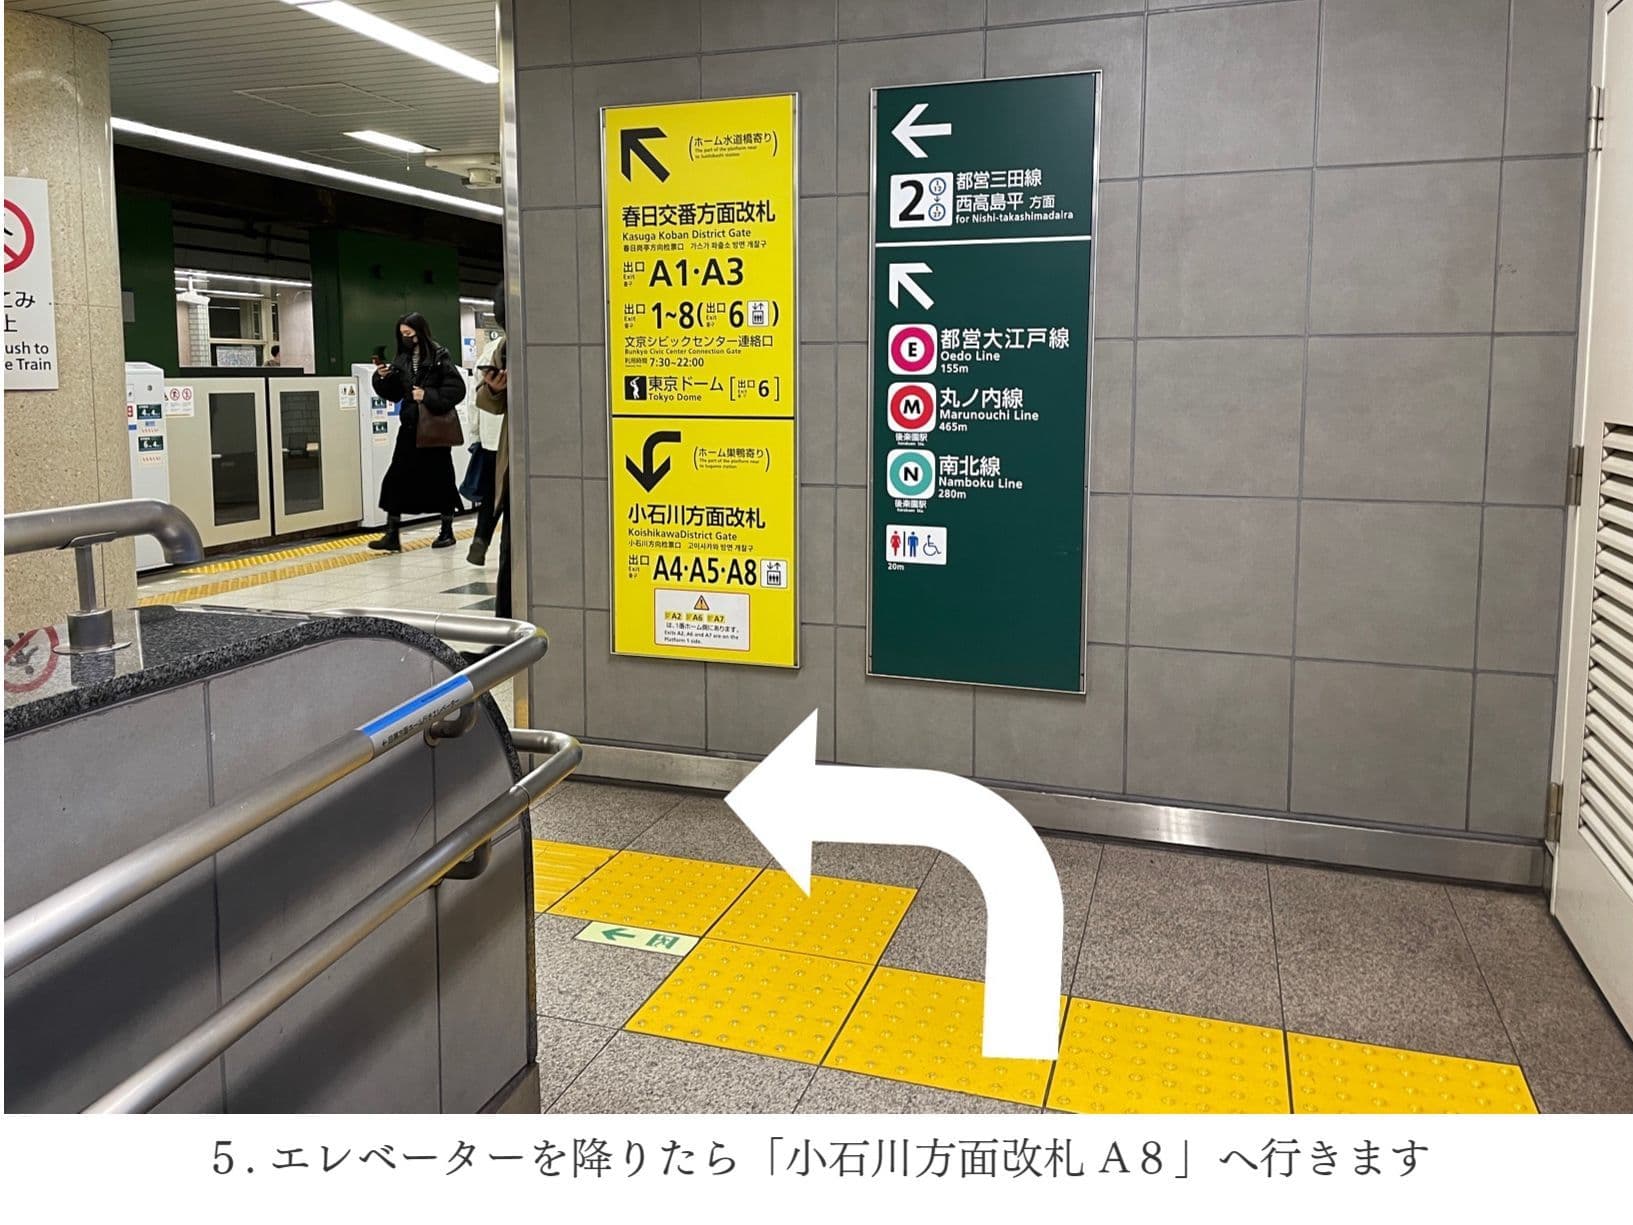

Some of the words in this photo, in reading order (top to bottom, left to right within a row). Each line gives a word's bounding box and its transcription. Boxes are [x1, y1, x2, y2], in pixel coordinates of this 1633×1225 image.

[956, 168, 1042, 190] 都営三田線
[898, 180, 924, 222] 2
[956, 192, 1024, 212] 西高島平
[1029, 194, 1056, 209] 方面
[622, 200, 776, 228] 春日交番方面改札
[956, 214, 970, 224] for
[972, 210, 1074, 224] Nishi-takashimadaira
[622, 232, 656, 242] Kasuga
[659, 230, 689, 240] Koban
[692, 229, 725, 239] District
[728, 228, 752, 238] Gate
[624, 261, 645, 273] 出口
[624, 303, 646, 314] 出口
[625, 335, 773, 348] 文京シビックセンター連絡口
[940, 328, 1070, 350] 都営大江戸線
[5, 341, 31, 354] ush
[34, 343, 49, 354] to
[908, 342, 917, 357] E
[940, 351, 972, 361] Oedo
[976, 350, 1000, 361] Line
[16, 358, 51, 370] Train
[941, 364, 968, 373] 155m
[648, 376, 724, 392] 東京ドーム
[758, 380, 770, 397] 6
[648, 393, 674, 403] Tokyo
[940, 387, 1024, 408] 丸ノ内線
[903, 400, 920, 414] M
[940, 409, 1010, 420] Marunouchi
[1014, 410, 1039, 421] Line
[939, 422, 968, 432] 465m
[938, 455, 1000, 477] 南北線
[904, 466, 918, 481] N
[938, 476, 994, 488] Namboku
[998, 478, 1023, 489] Line
[938, 489, 966, 499] 280m
[628, 503, 766, 529] 小石川方面改札
[716, 533, 737, 541] Gate
[628, 554, 650, 566] 出口
